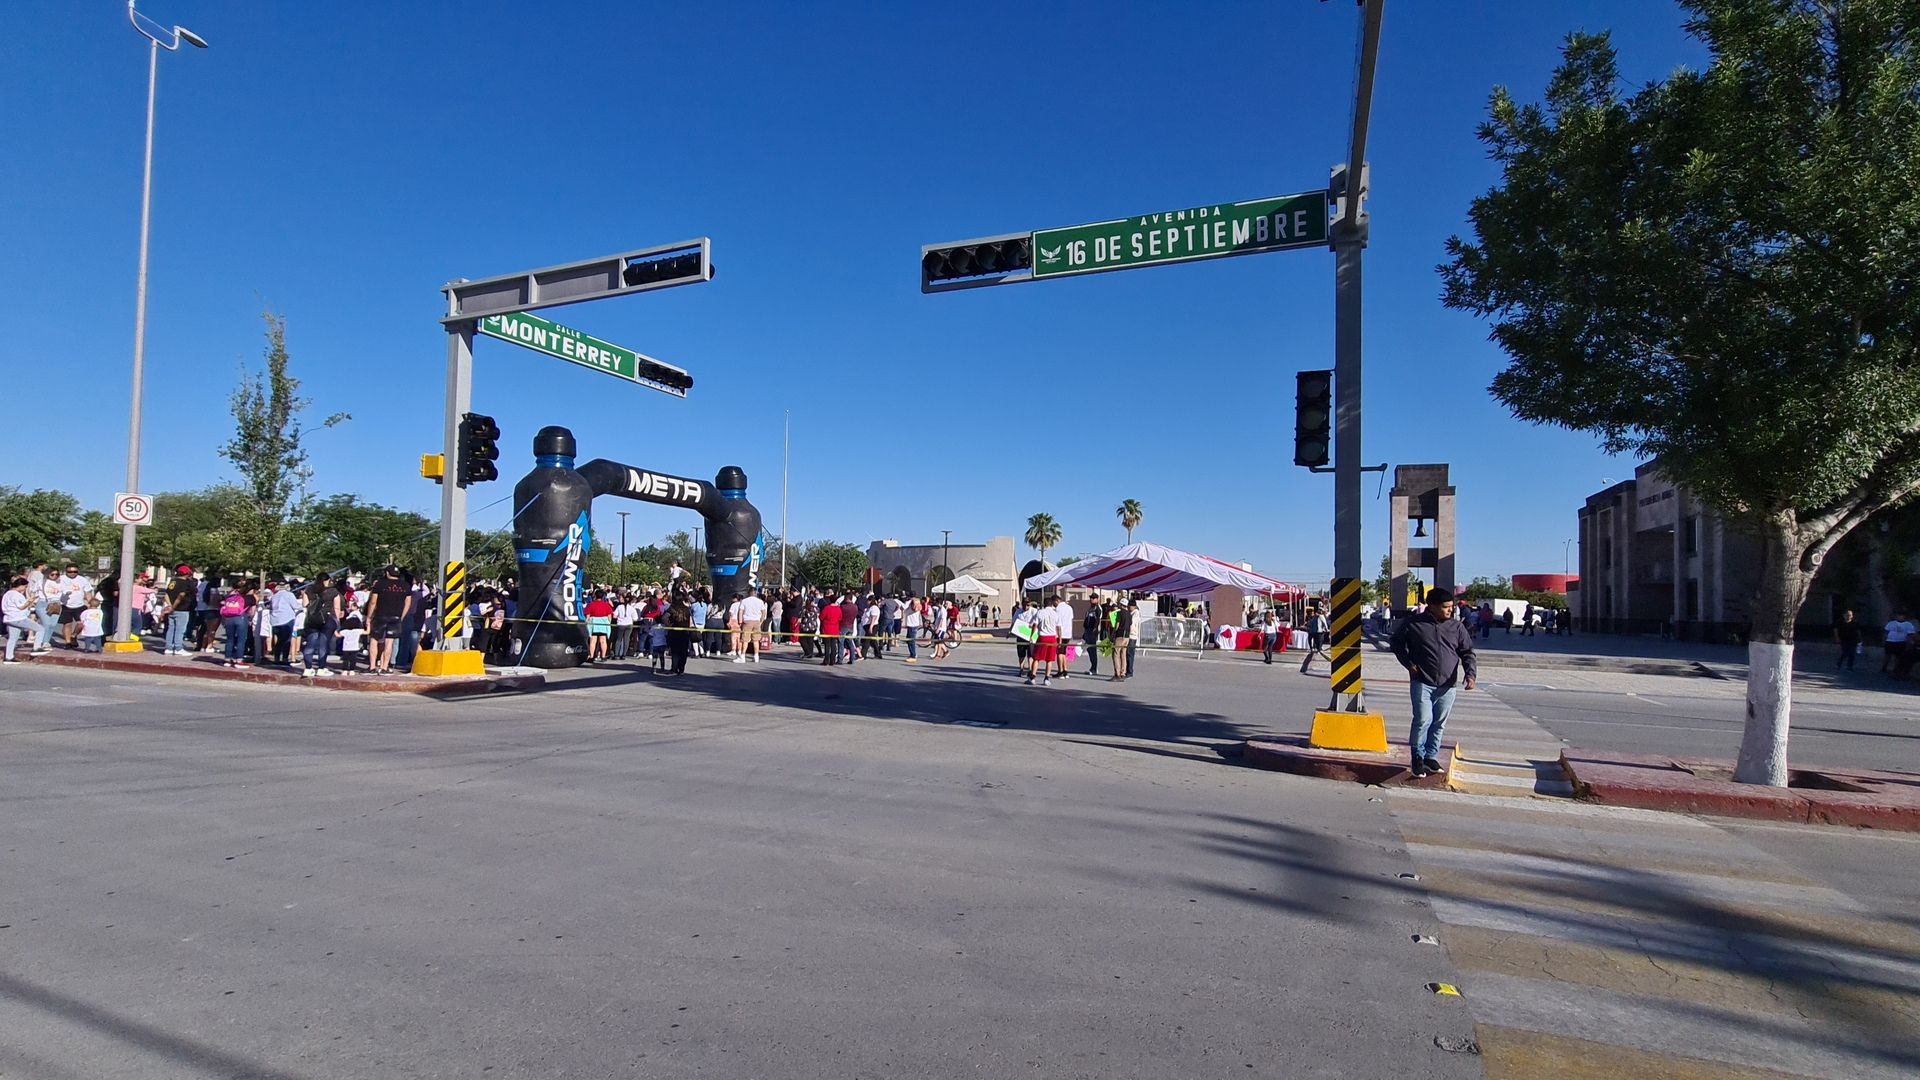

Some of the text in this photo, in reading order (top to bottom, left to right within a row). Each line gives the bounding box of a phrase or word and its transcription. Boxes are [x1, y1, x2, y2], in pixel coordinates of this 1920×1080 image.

[1140, 206, 1221, 226] AVENIDA
[1065, 209, 1308, 266] 16 DE SEPTIEMBRE
[501, 316, 622, 371] MONTERREY
[556, 324, 581, 339] CALLE
[628, 469, 702, 503] META
[125, 501, 142, 513] 50
[563, 523, 583, 621] POWER
